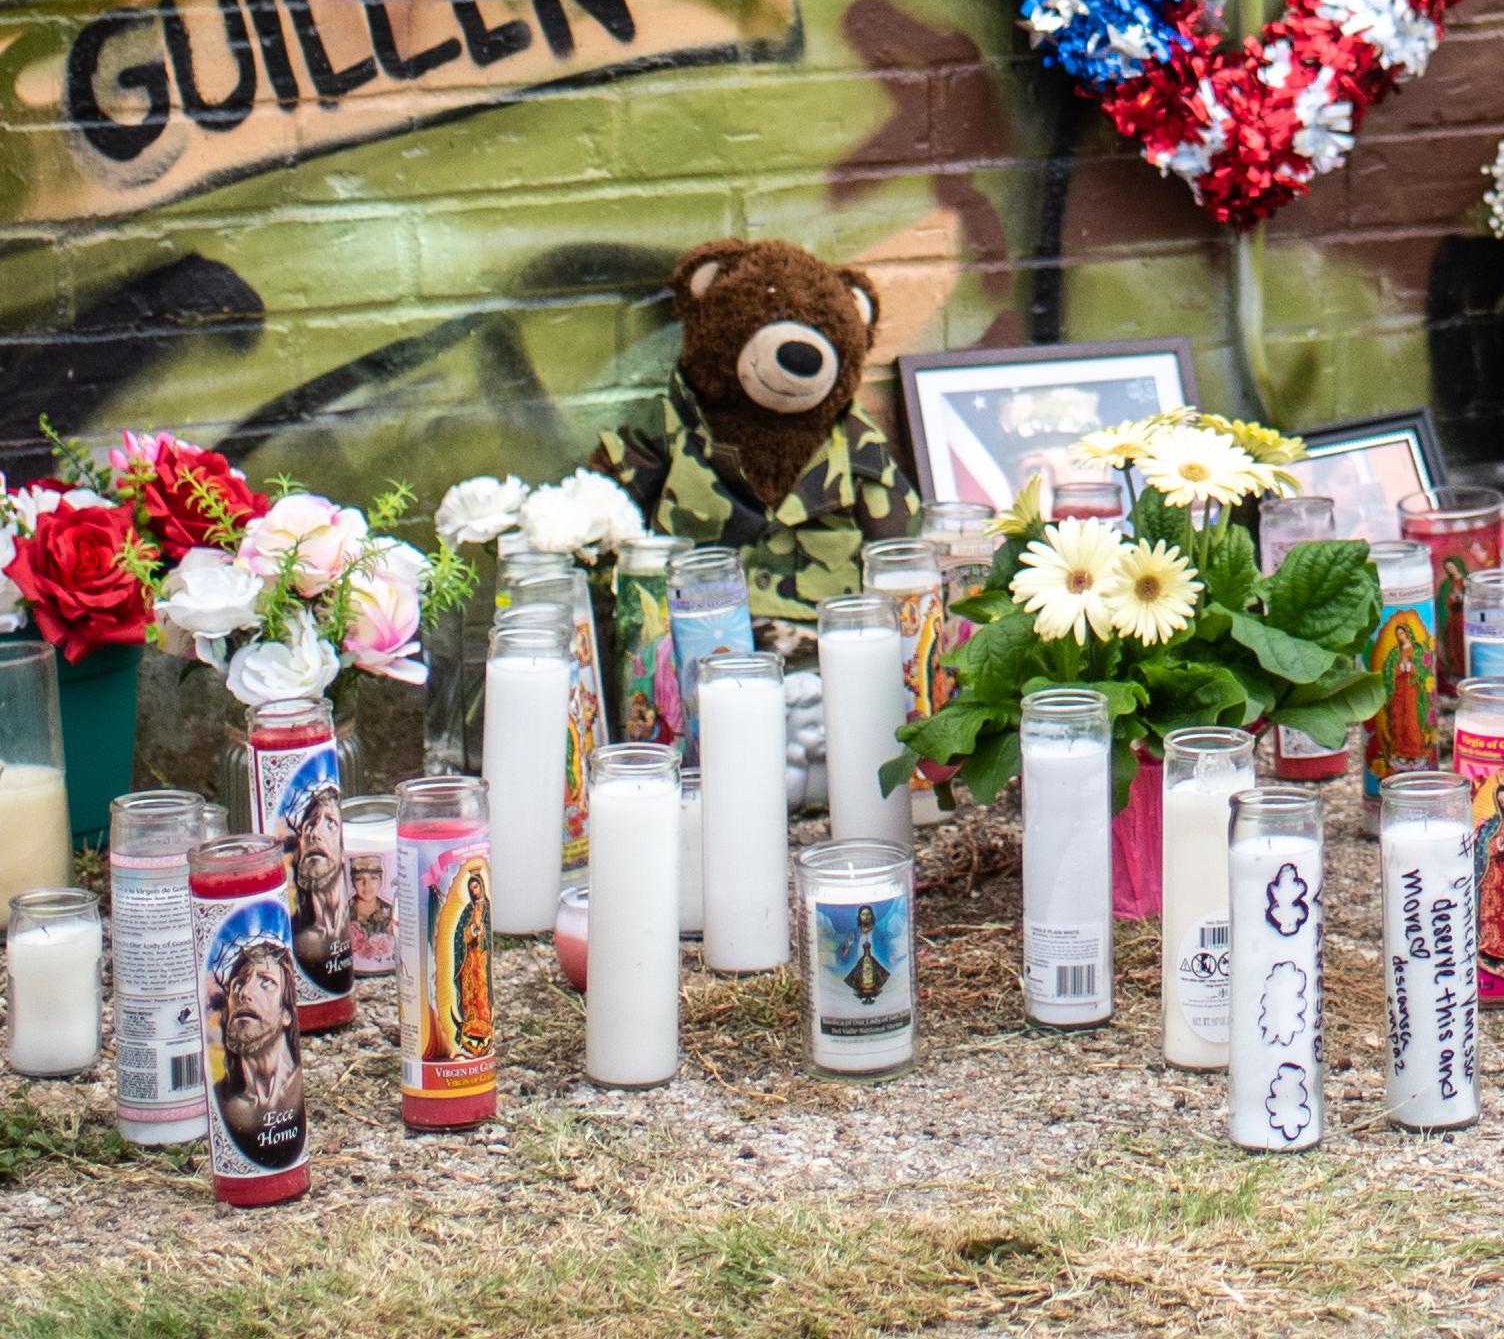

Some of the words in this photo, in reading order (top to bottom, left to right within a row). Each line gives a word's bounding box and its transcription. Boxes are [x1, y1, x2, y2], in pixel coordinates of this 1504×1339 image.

[1438, 1048, 1458, 1101] and
[262, 1107, 295, 1127] Ecce
[257, 1124, 299, 1148] Homo
